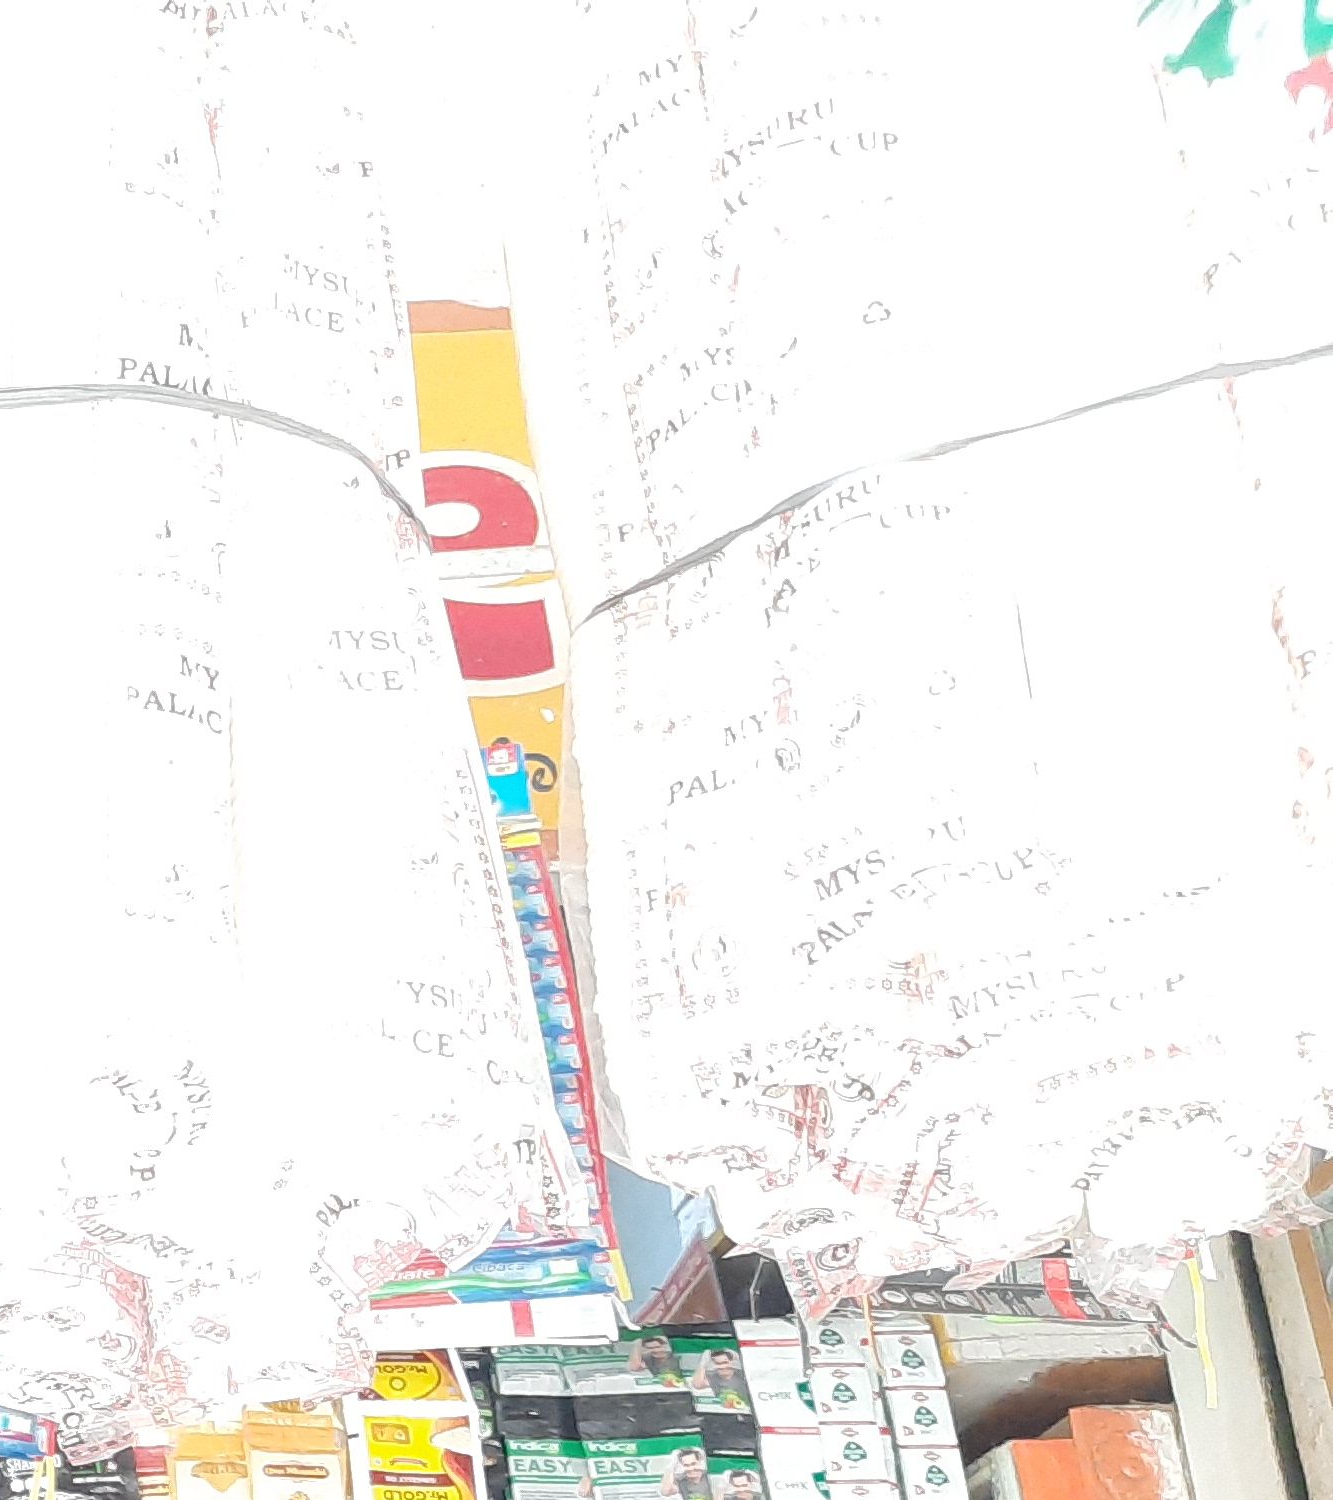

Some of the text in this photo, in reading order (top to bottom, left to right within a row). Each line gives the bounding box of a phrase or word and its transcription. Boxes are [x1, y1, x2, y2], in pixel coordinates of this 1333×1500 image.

[374, 1364, 430, 1376] Mr.GOL
[513, 1458, 572, 1474] EASY
[593, 1458, 652, 1475] EASY
